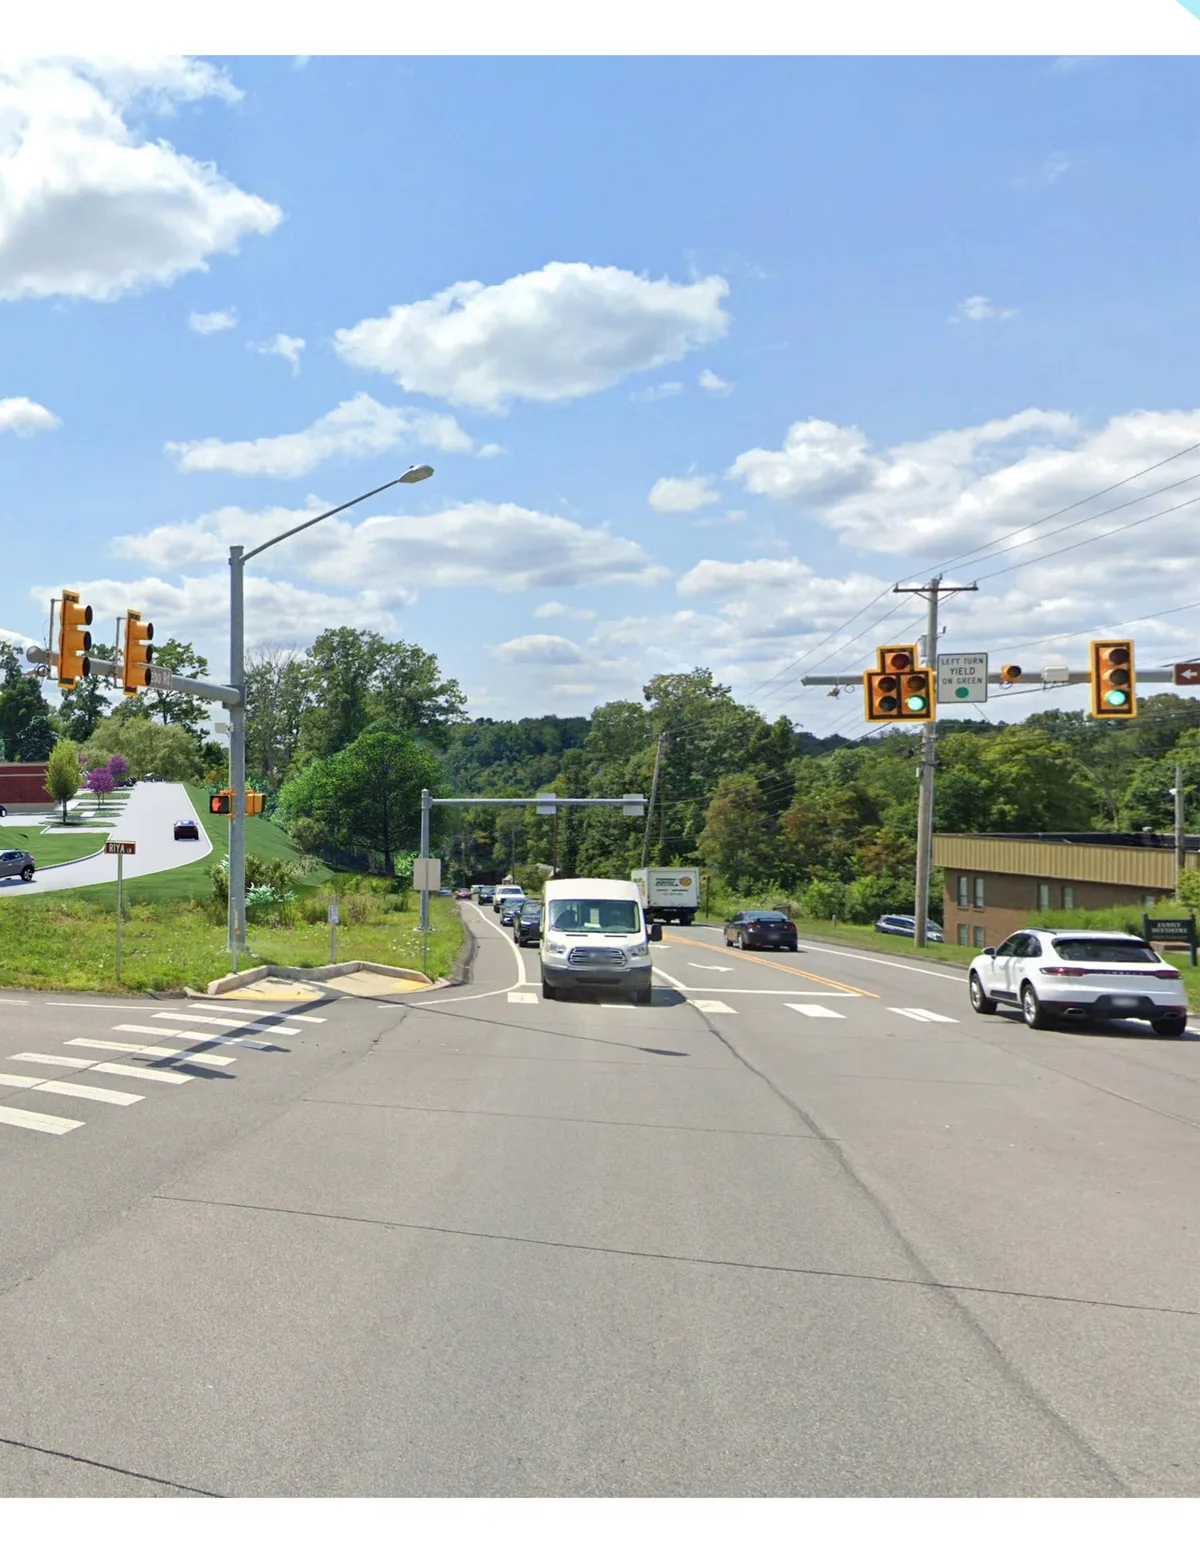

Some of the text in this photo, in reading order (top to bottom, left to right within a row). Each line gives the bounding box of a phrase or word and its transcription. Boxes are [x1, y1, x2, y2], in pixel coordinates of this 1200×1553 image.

[941, 657, 983, 665] LEFT TURN
[949, 667, 976, 675] YIELD
[956, 677, 982, 685] GREEN
[108, 843, 125, 853] RIYA
